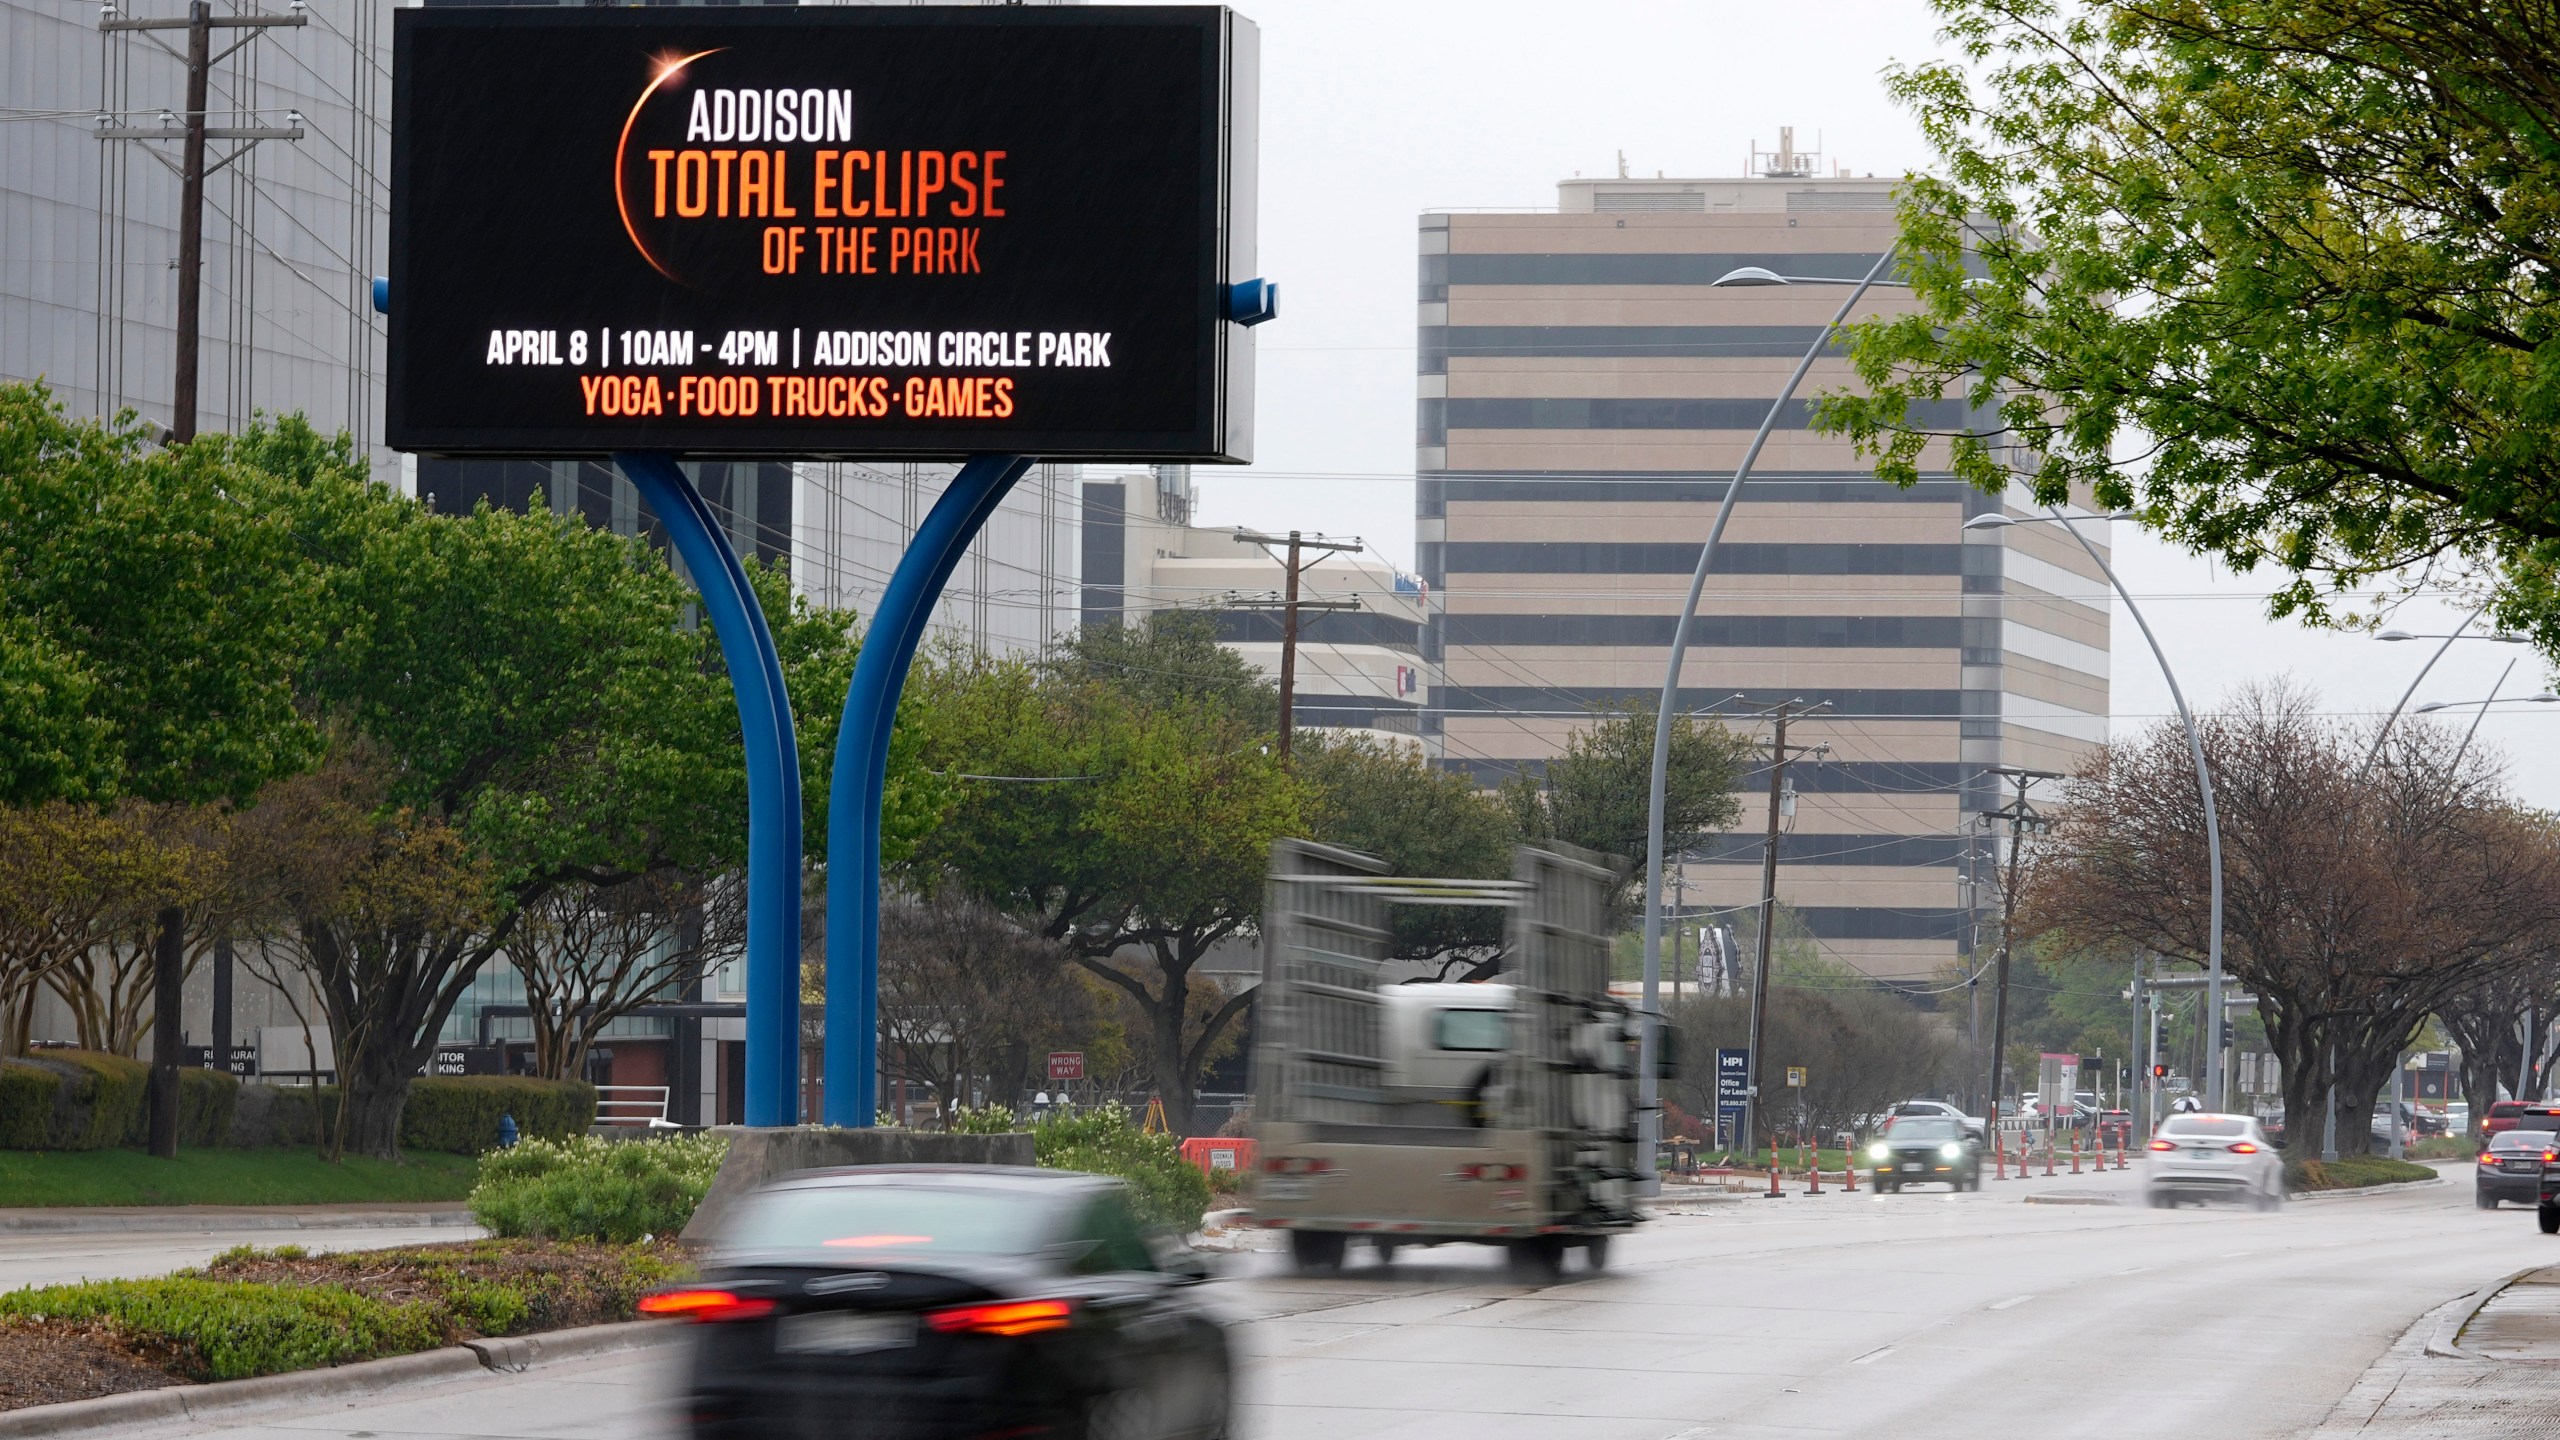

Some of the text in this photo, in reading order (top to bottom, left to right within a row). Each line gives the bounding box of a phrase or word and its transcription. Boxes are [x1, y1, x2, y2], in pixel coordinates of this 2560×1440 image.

[687, 89, 852, 143] ADDISON
[648, 150, 1007, 218] TOTAL ECLIPSE
[763, 227, 981, 275] OF THE PARK
[487, 330, 564, 366] APRIL
[569, 330, 588, 366] 8
[620, 330, 694, 366] 10AM
[719, 330, 779, 366] 4PM
[814, 330, 932, 367] ADDISON
[937, 330, 1032, 367] CIRCLE
[1039, 331, 1112, 368] PARK
[438, 1053, 465, 1062] ITOR
[1051, 1057, 1081, 1065] WRONG
[1723, 1057, 1743, 1066] HPI
[1057, 1067, 1075, 1075] WAY
